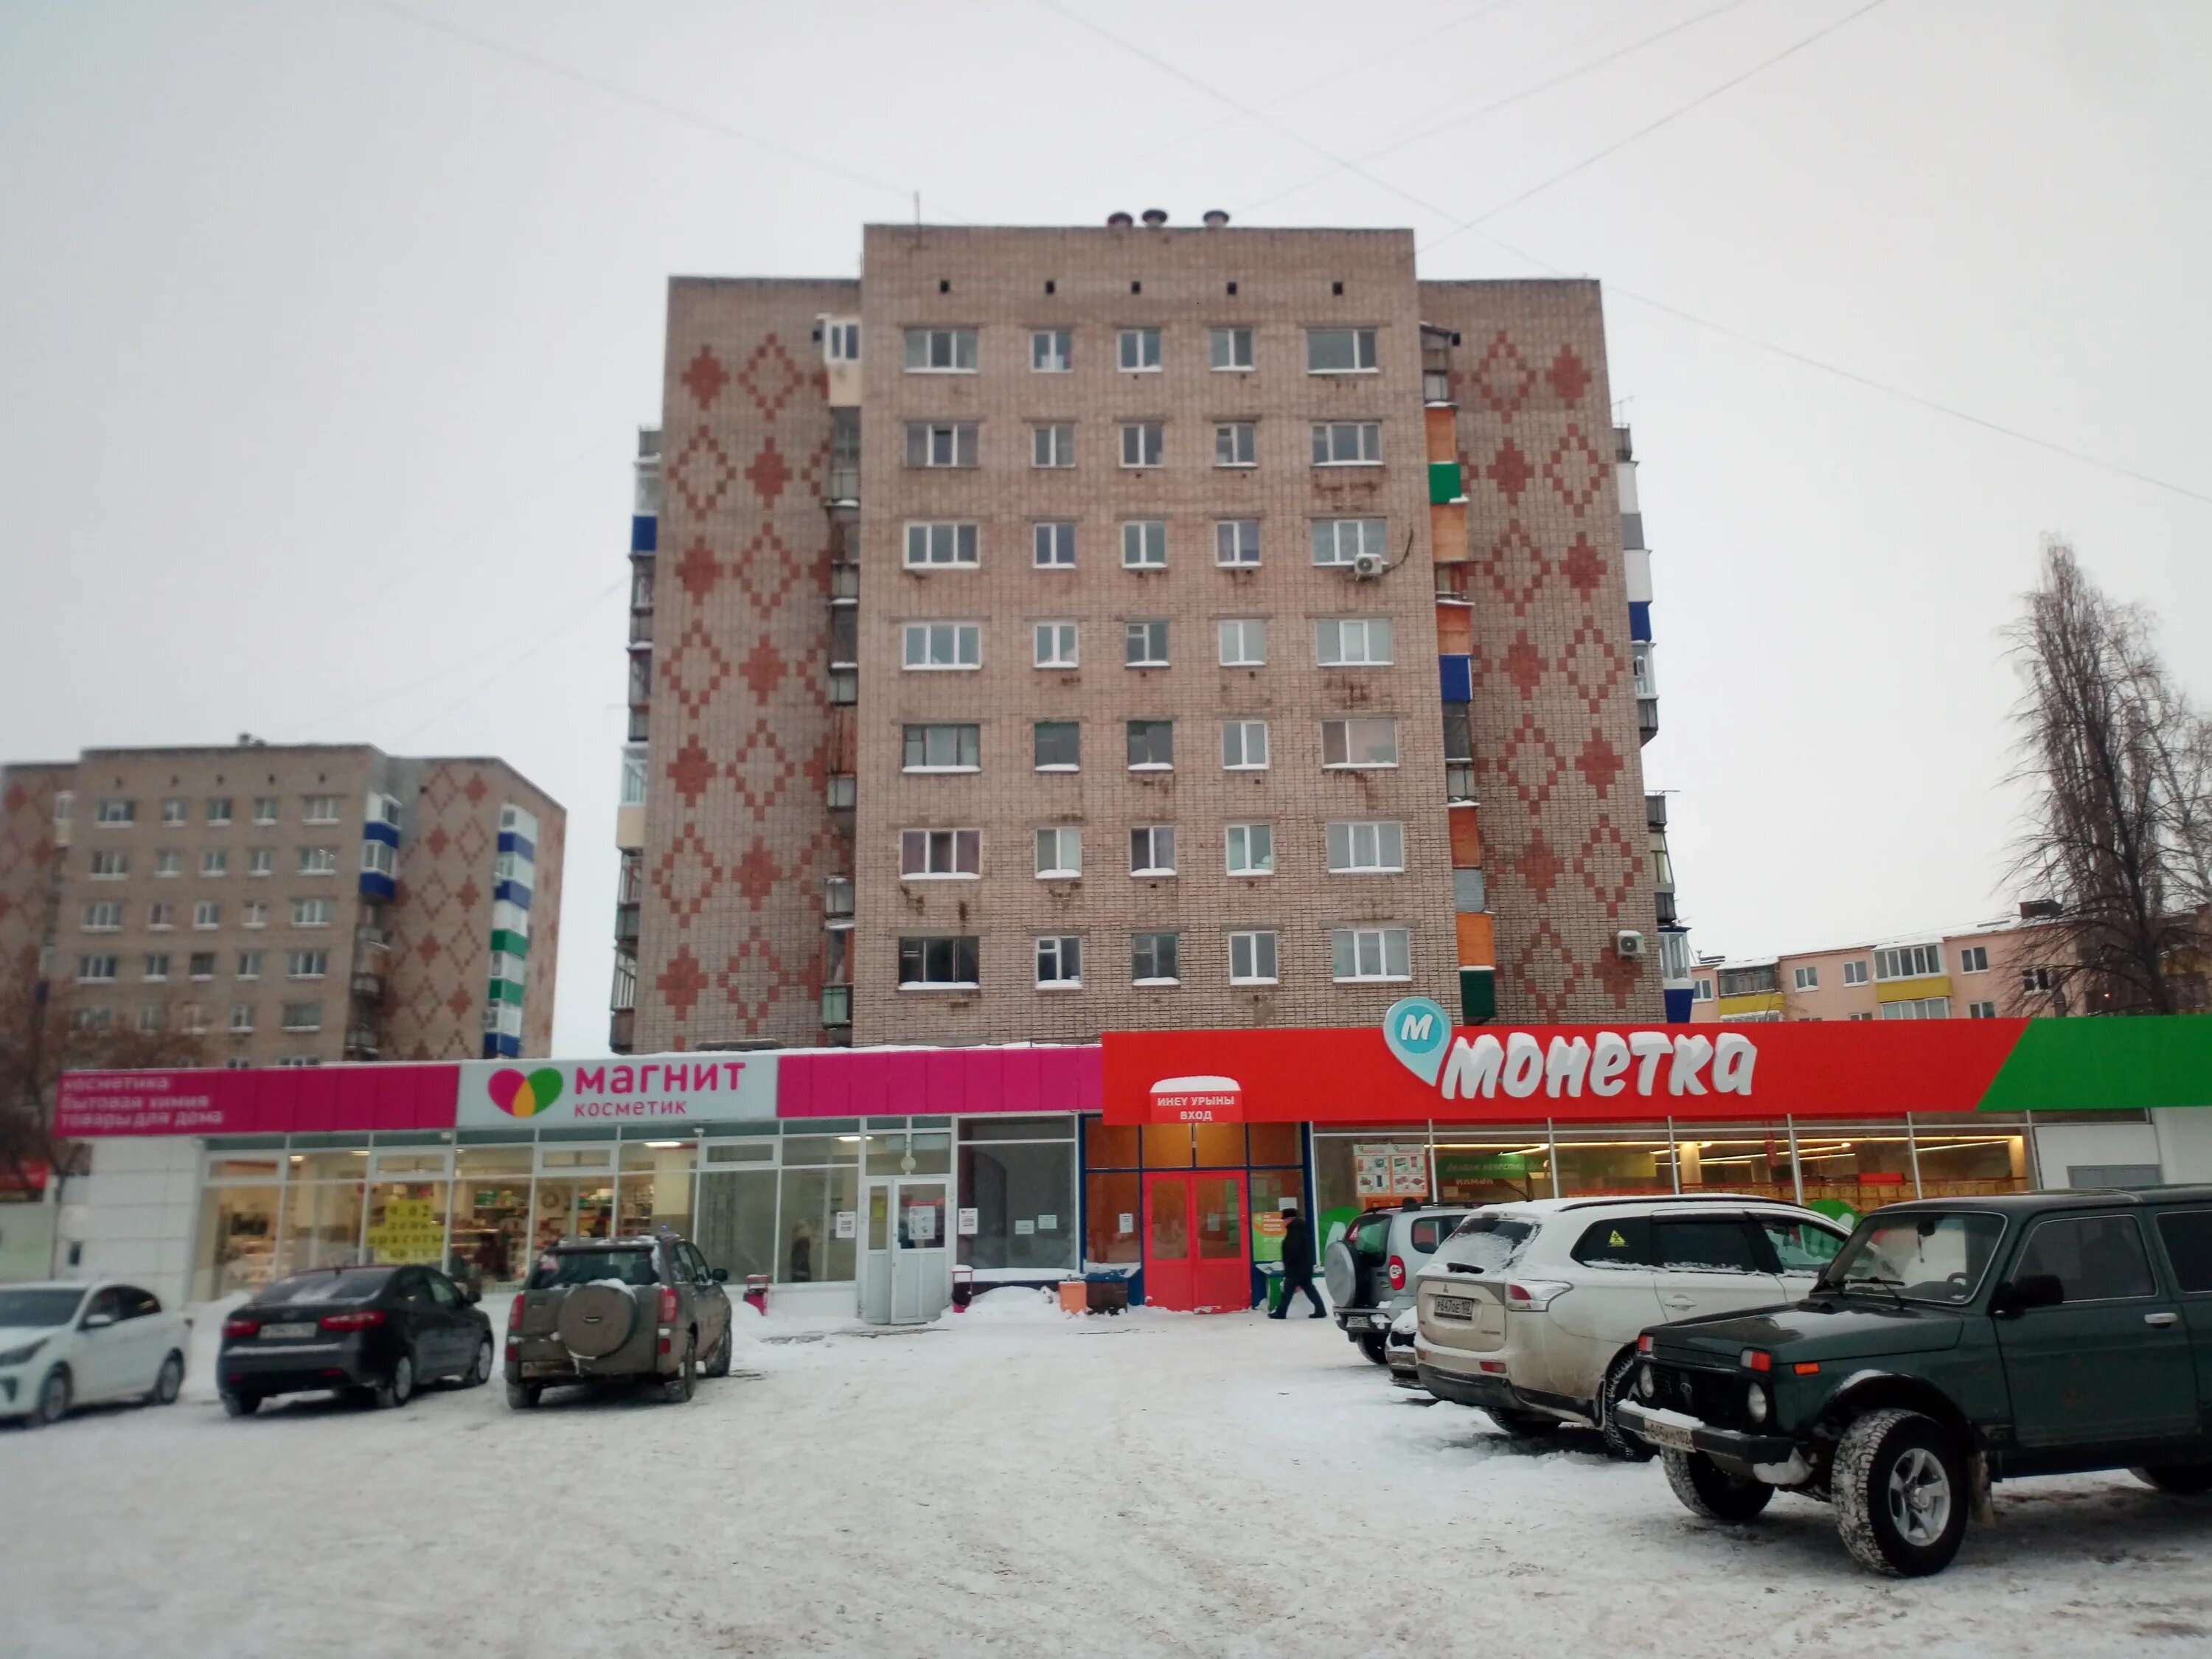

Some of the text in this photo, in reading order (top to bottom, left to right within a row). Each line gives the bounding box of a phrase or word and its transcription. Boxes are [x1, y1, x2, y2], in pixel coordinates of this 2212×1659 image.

[63, 1077, 170, 1092] косметика
[61, 1093, 209, 1111] бытовая химия
[574, 1100, 687, 1118] косметик
[1191, 1096, 1235, 1106] УРЫНЫ
[61, 1110, 223, 1129] товары для дома
[1180, 1110, 1213, 1121] ВХОД
